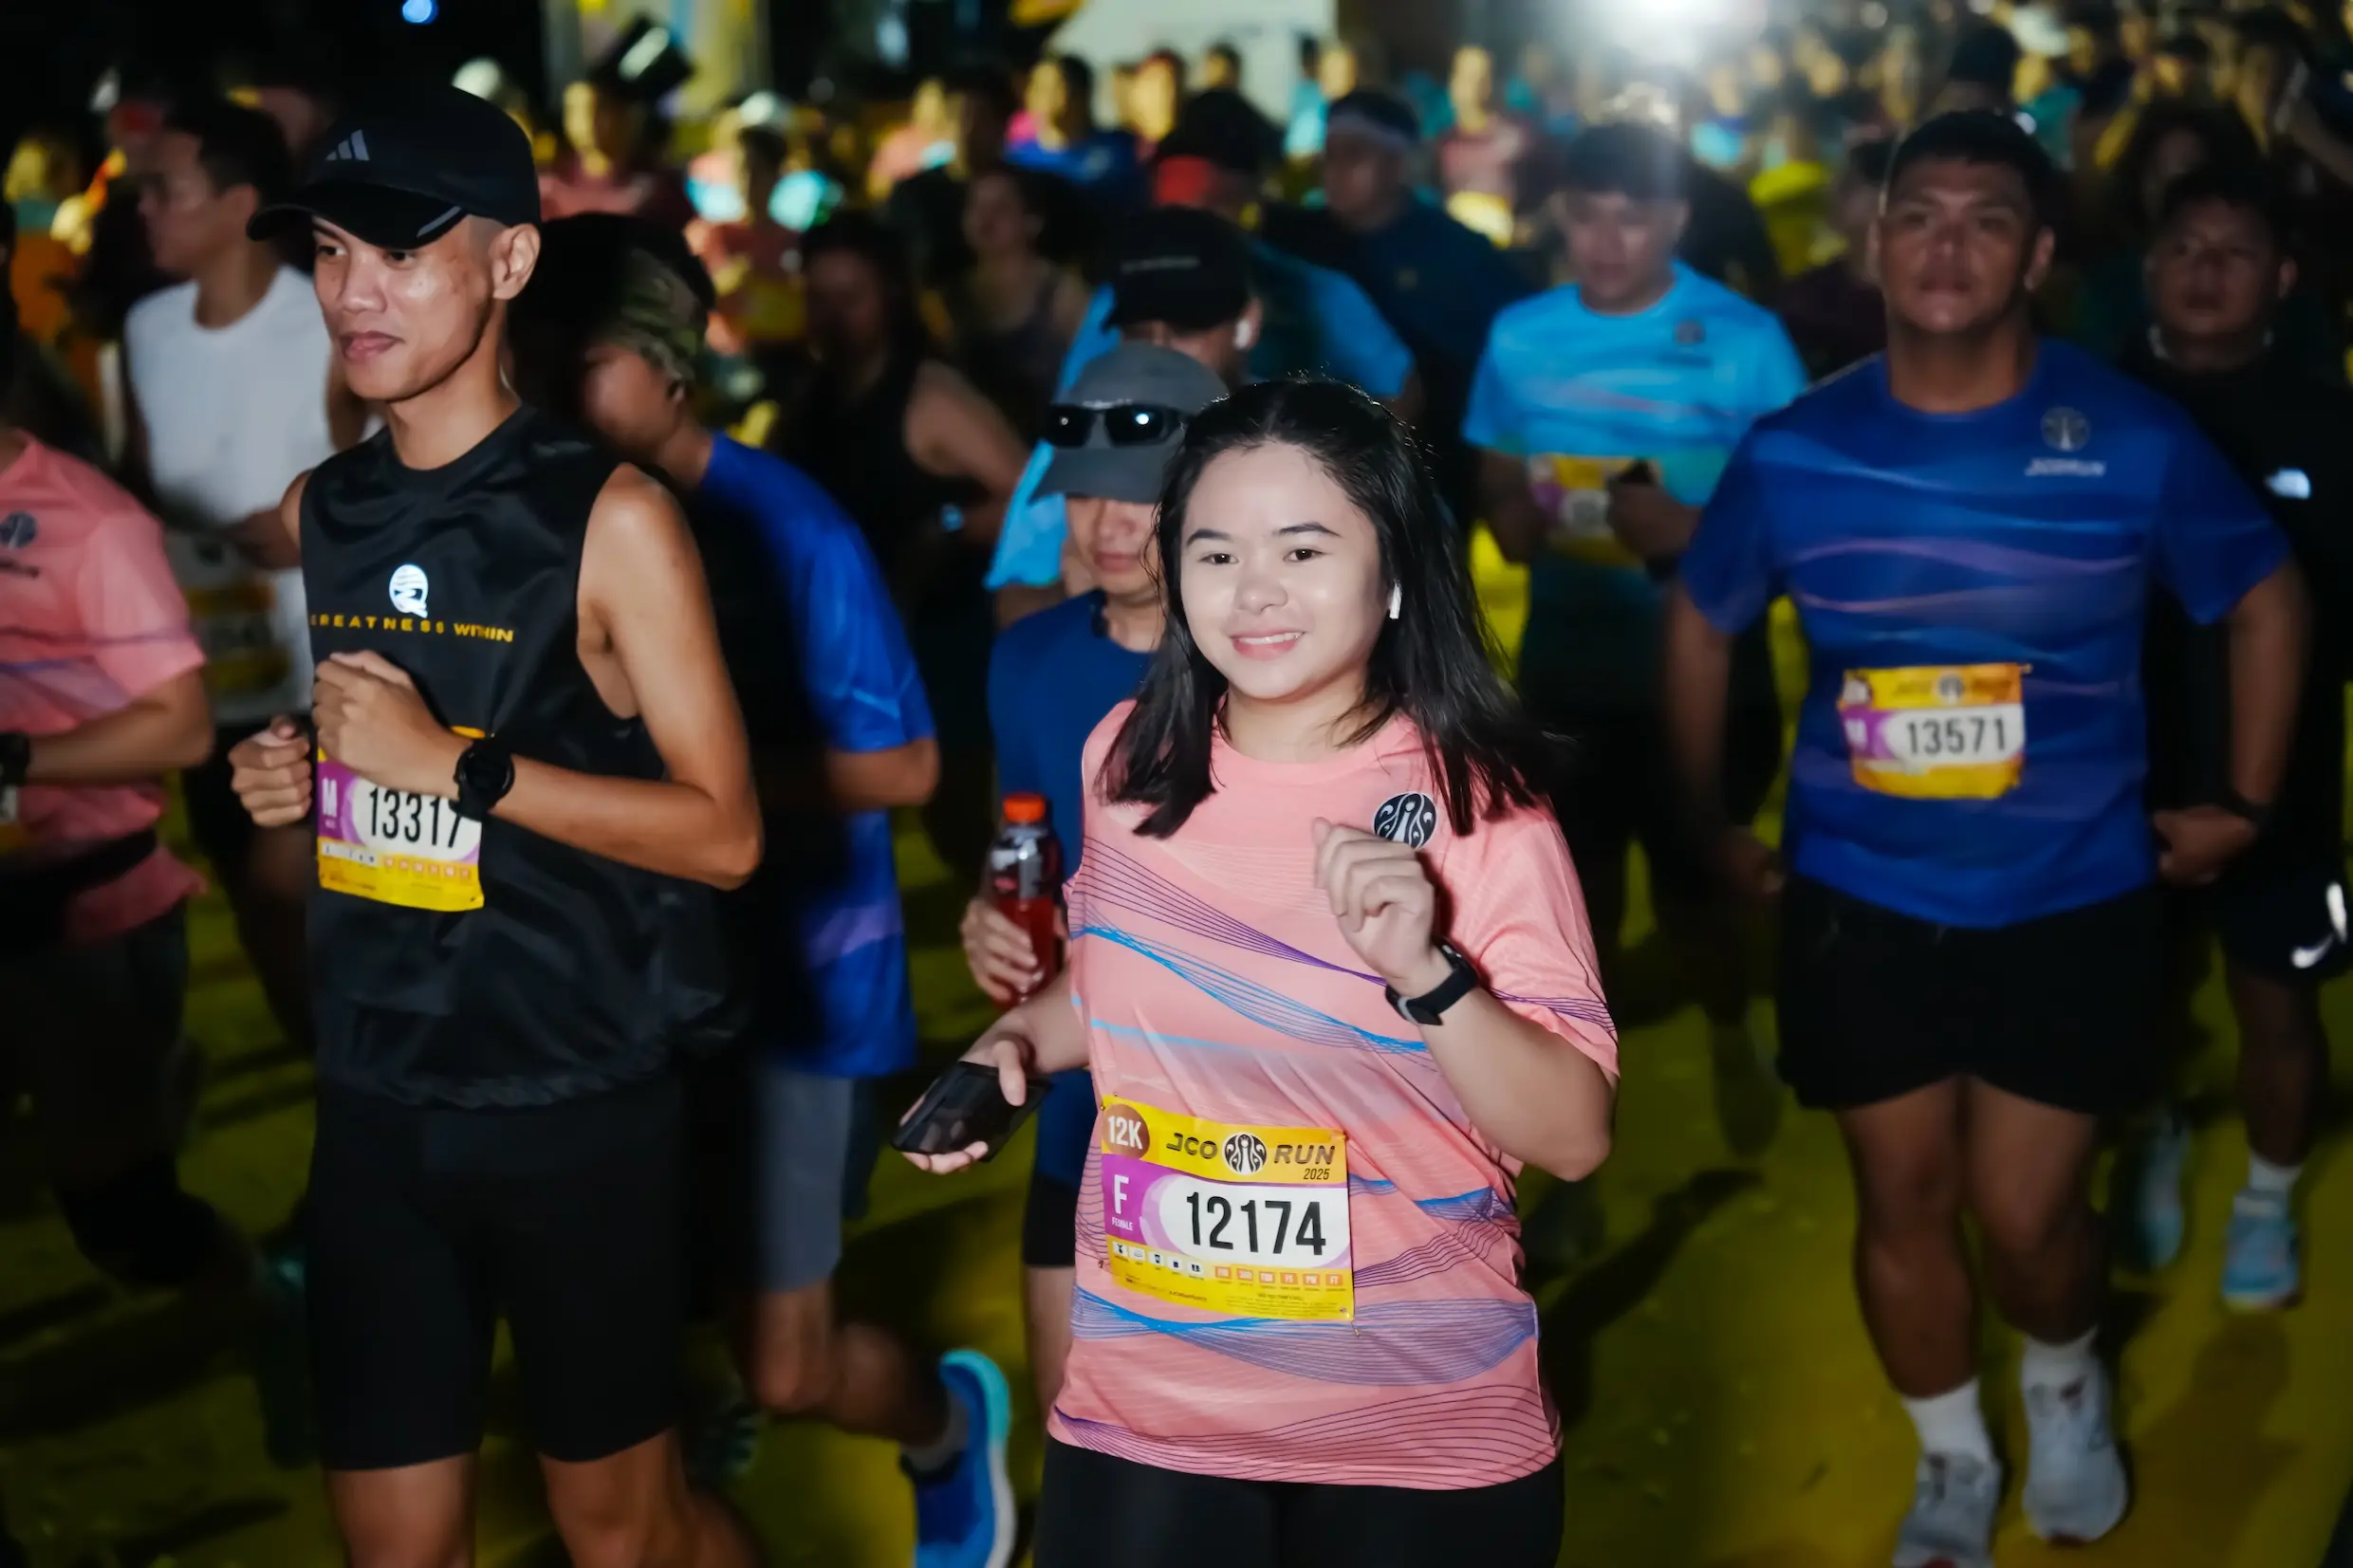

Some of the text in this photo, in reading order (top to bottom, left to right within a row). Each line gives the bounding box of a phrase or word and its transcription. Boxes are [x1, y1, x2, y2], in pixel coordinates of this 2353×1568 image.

[1907, 717, 2006, 755] 13571
[322, 777, 338, 818] M
[1107, 1116, 1143, 1150] 12K
[1166, 1133, 1336, 1165] JCO RUN
[1303, 1168, 1330, 1181] 2025
[1114, 1174, 1129, 1215] F
[1111, 1216, 1134, 1231] FEMALE
[1186, 1191, 1326, 1256] 12174
